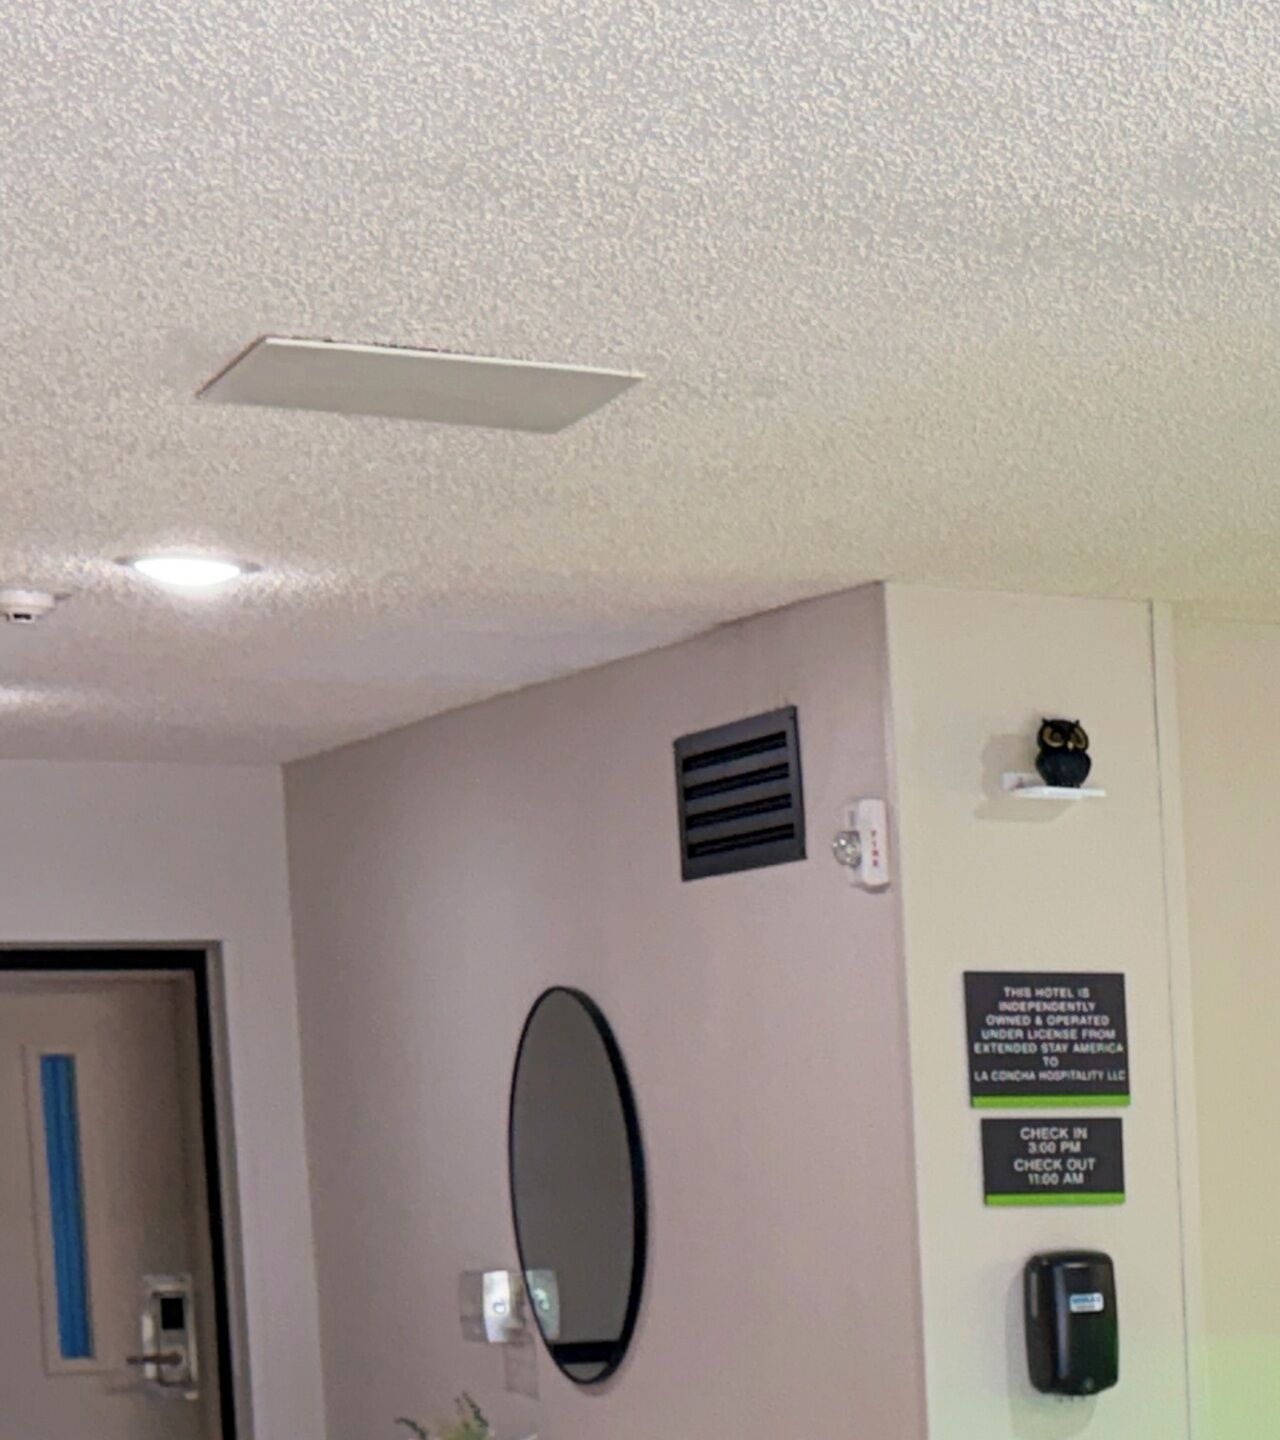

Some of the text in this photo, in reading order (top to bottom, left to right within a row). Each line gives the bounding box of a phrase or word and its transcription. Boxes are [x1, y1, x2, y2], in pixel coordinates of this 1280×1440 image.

[1003, 986, 1090, 998] THIS HOTEL IS
[998, 1001, 1096, 1012] INDEPENDENTLY
[986, 1014, 1110, 1026] OWNED & OPERATED
[981, 1028, 1116, 1039] UNDER LICENSE FROM
[973, 1042, 1124, 1054] EXTENDED STAY AMERICA
[1042, 1056, 1059, 1067] TO
[974, 1070, 1126, 1081] LA CONCHA HOSPITALITY LLC
[1020, 1126, 1088, 1140] CHECK IN
[1028, 1140, 1082, 1154] 3:00 PM
[1013, 1157, 1096, 1172] CHECK OUT
[1027, 1172, 1084, 1185] 11:00 AM
